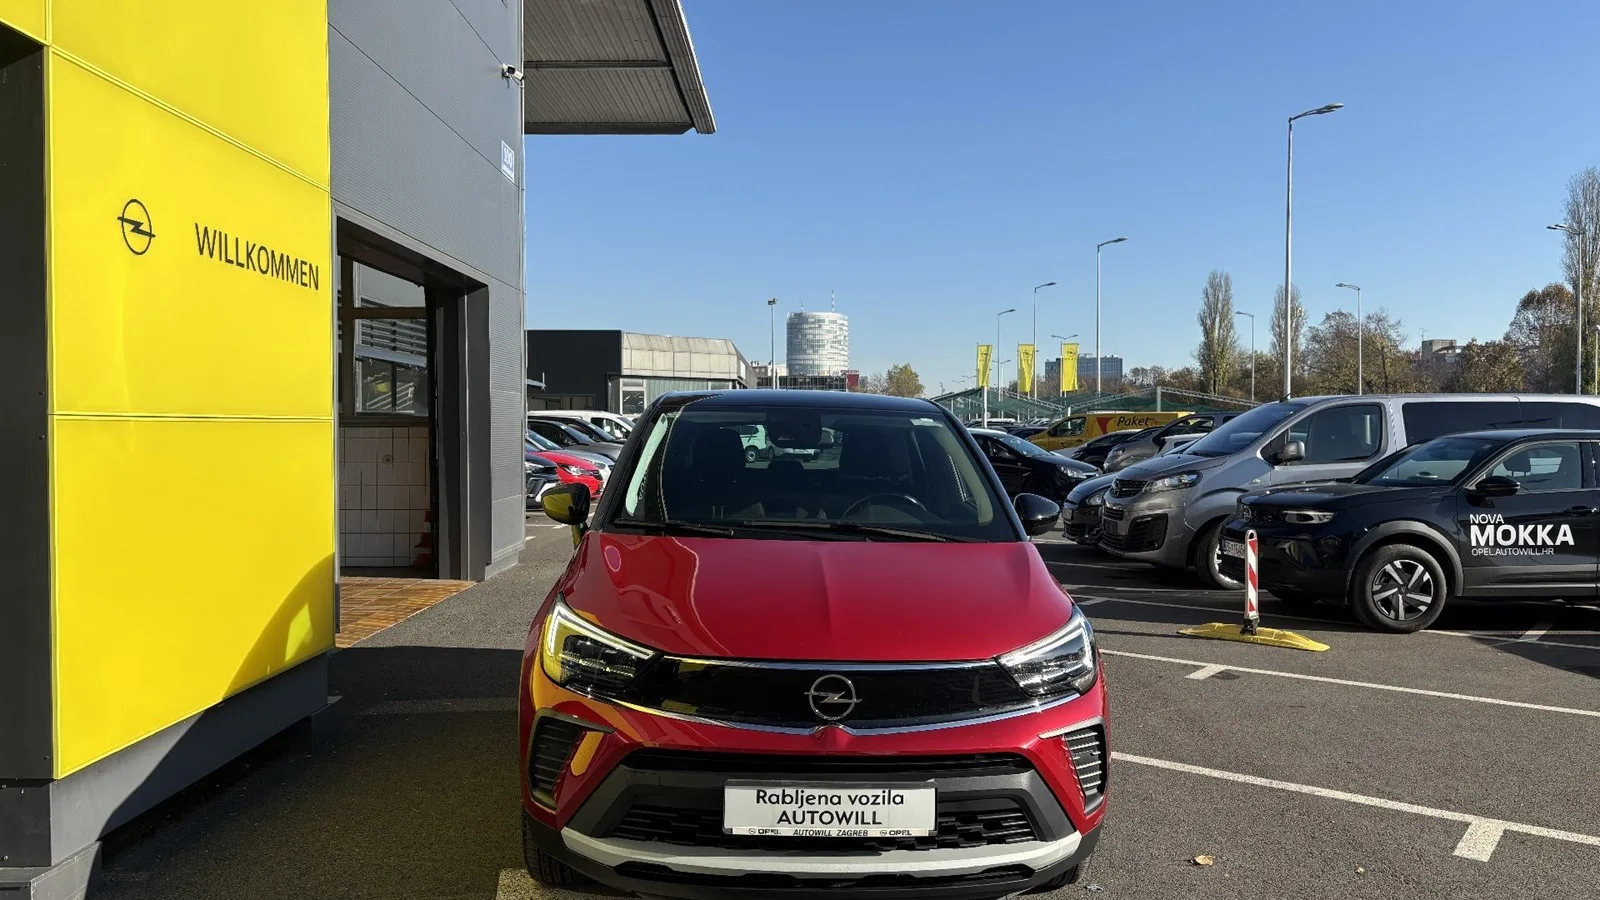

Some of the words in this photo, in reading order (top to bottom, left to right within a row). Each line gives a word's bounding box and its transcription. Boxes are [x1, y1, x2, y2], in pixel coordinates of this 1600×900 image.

[195, 223, 319, 290] WILLKOMMEN
[1470, 514, 1505, 524] NOVA
[1470, 524, 1575, 547] MOKKA
[756, 789, 842, 808] Rabljena
[848, 789, 905, 806] vozila
[776, 810, 883, 825] AUTOWILL
[792, 829, 833, 837] AUTOWILL
[836, 829, 869, 837] ZAGREB
